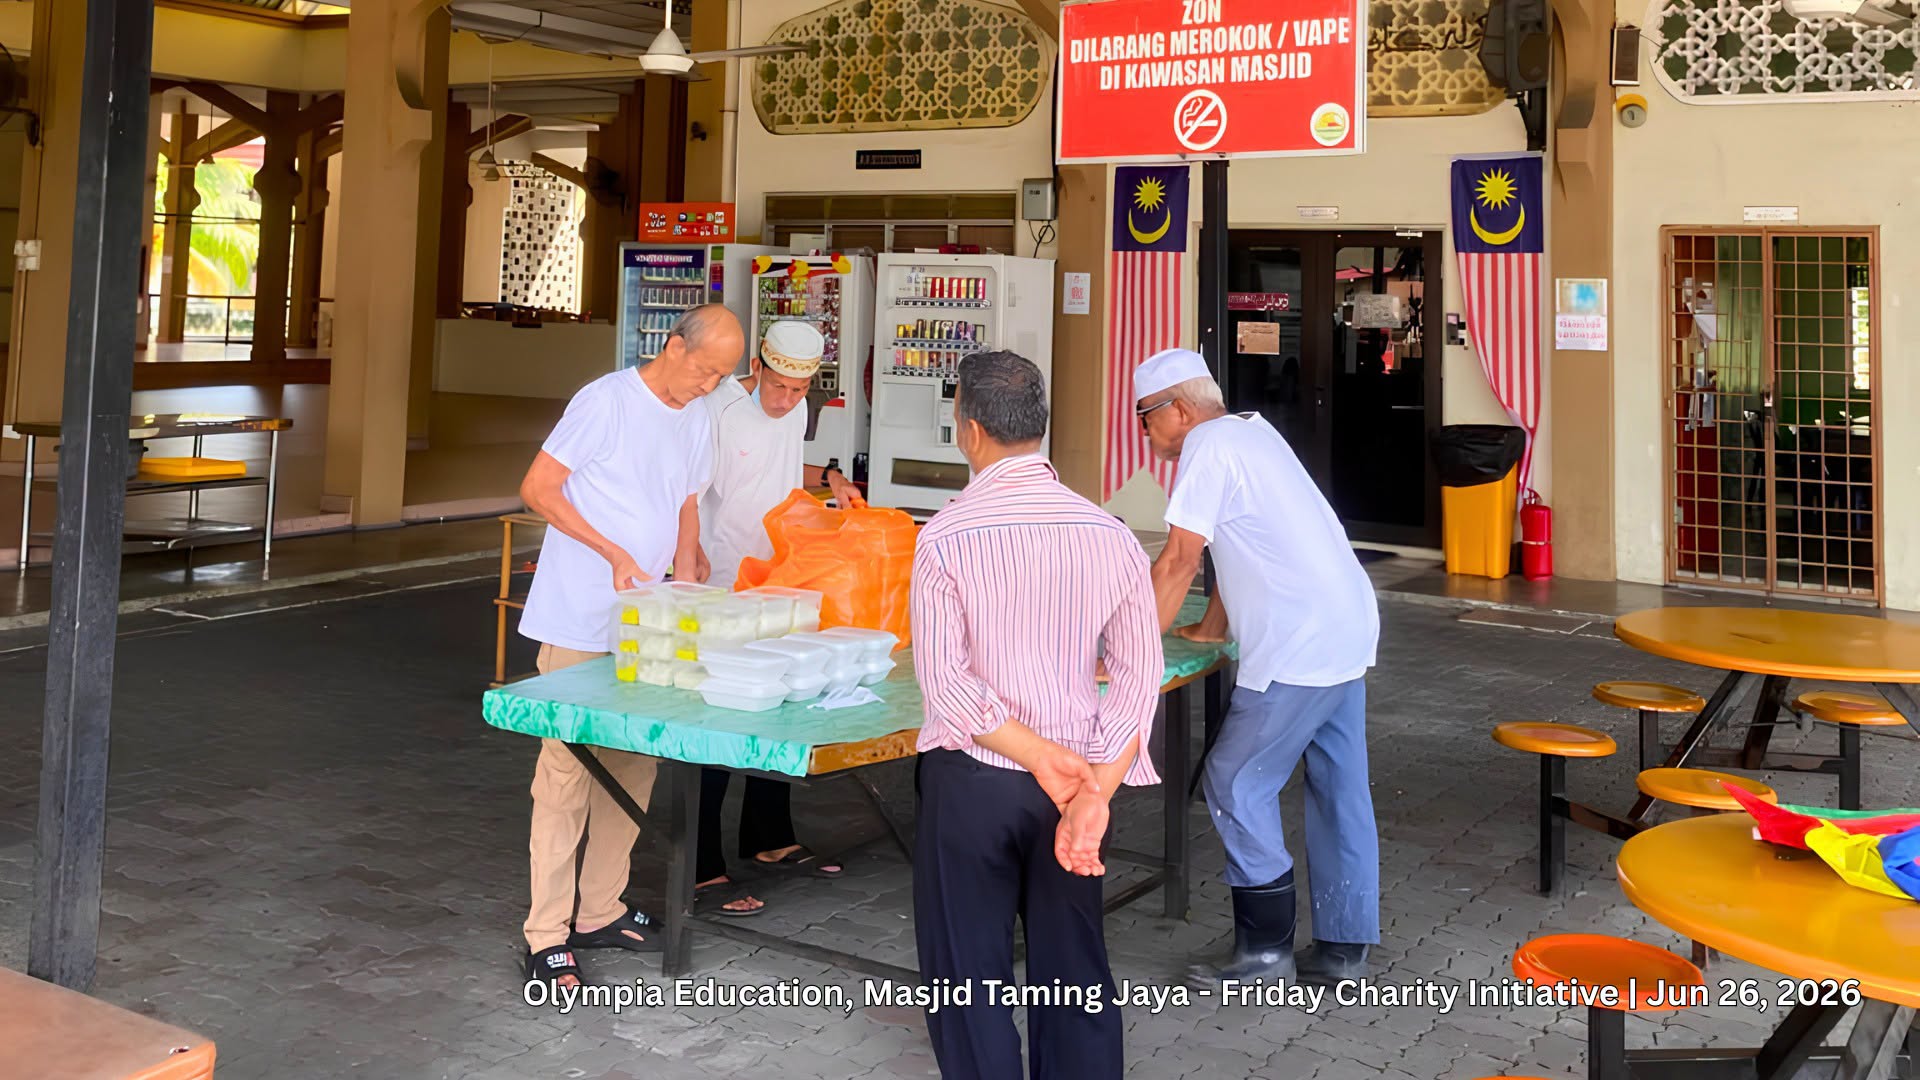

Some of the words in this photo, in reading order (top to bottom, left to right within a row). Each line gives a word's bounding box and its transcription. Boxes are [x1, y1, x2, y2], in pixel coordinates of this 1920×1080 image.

[1182, 0, 1221, 25] ZON
[1070, 31, 1165, 64] DILARANG
[1169, 23, 1273, 57] MEROKOK
[1277, 21, 1289, 50] /
[1293, 17, 1350, 48] VAPE
[1100, 64, 1121, 91] DI
[1125, 57, 1225, 89] KAWASAN
[1230, 52, 1312, 83] MASJID
